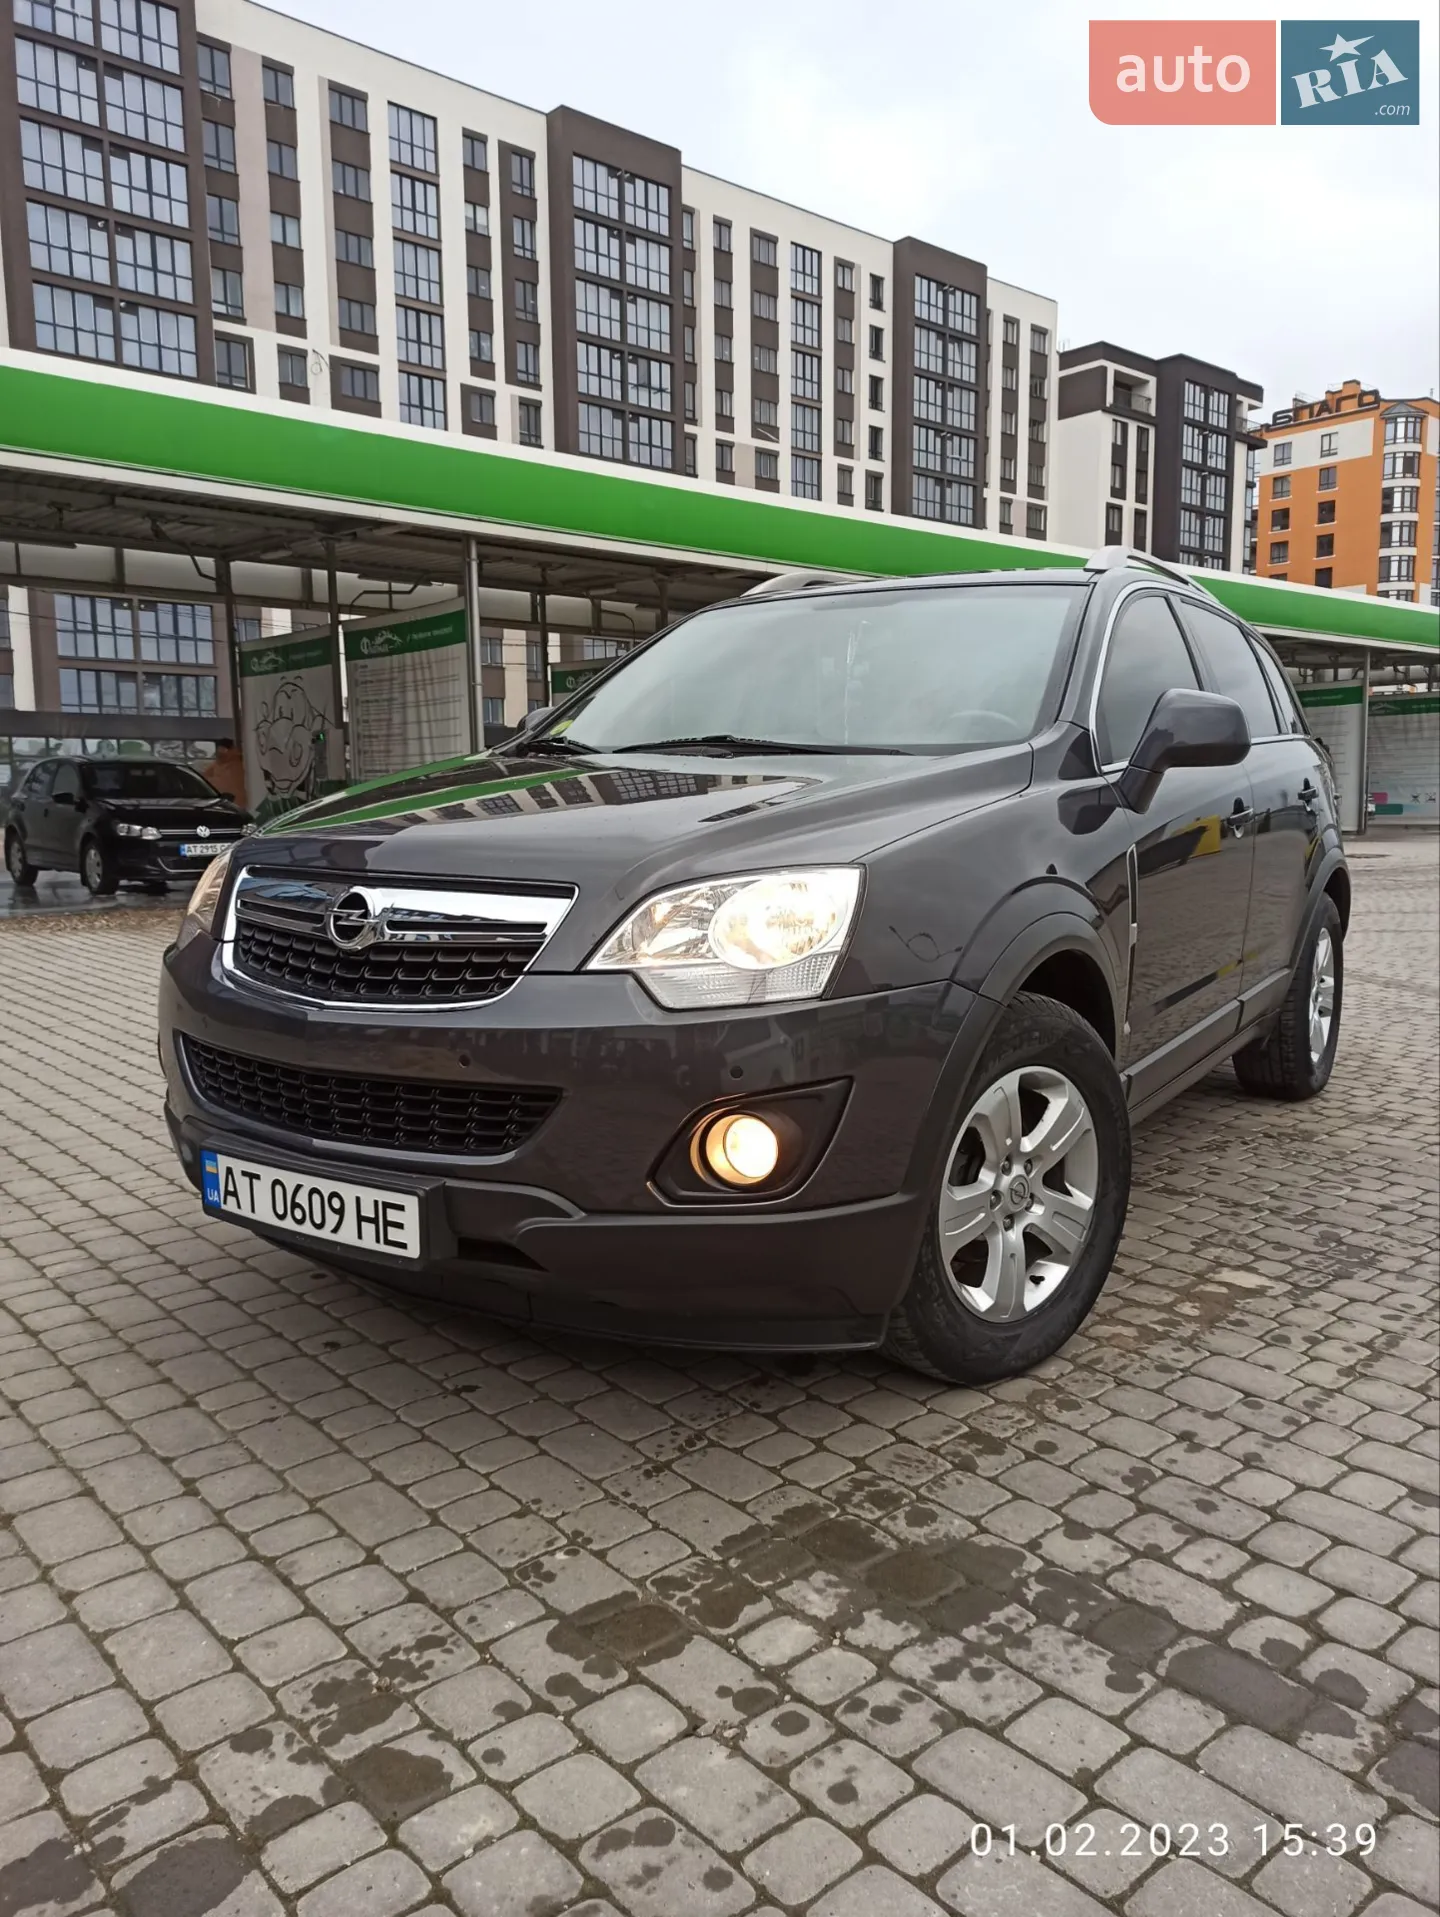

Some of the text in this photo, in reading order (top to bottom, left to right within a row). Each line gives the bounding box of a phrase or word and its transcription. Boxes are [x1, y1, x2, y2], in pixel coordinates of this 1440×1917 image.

[187, 845, 198, 854] AT
[200, 844, 218, 854] 2915
[207, 1187, 220, 1203] UA
[223, 1166, 408, 1250] AT 0609 HE
